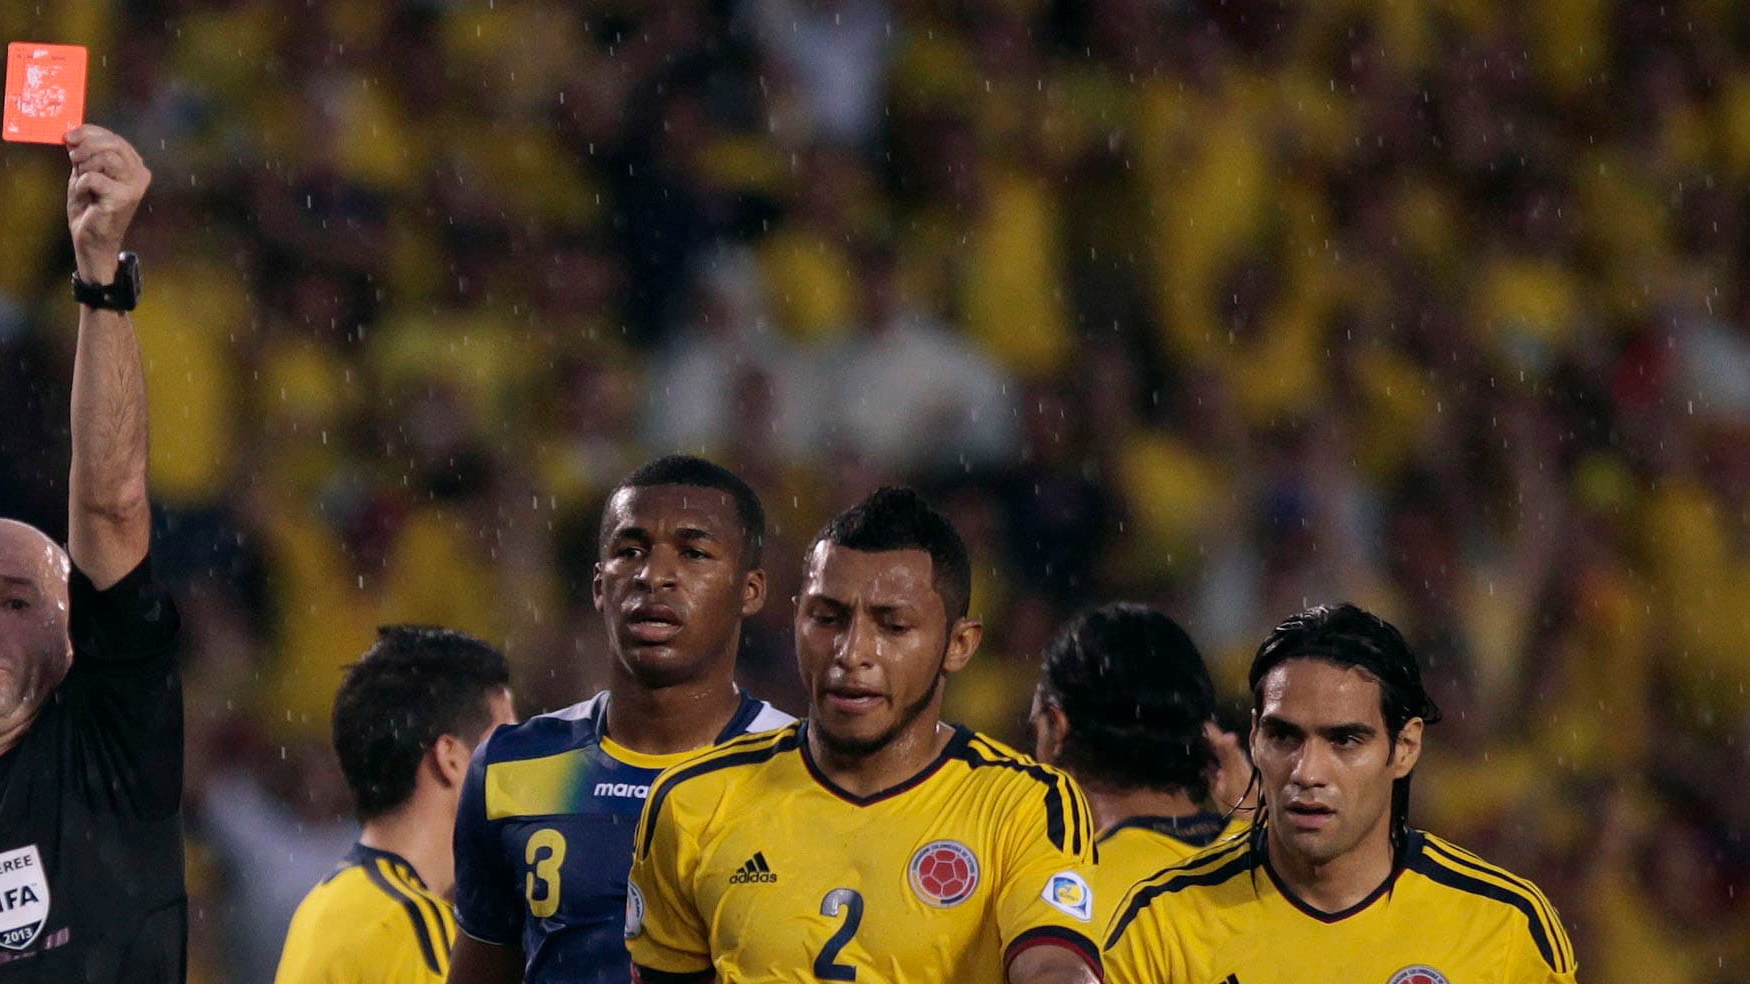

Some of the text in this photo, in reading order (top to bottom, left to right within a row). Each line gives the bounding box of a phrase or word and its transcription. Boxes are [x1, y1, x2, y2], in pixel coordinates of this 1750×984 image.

[525, 828, 567, 918] 3
[729, 871, 777, 885] adidas
[2, 927, 33, 945] 2013
[814, 888, 864, 982] 2
